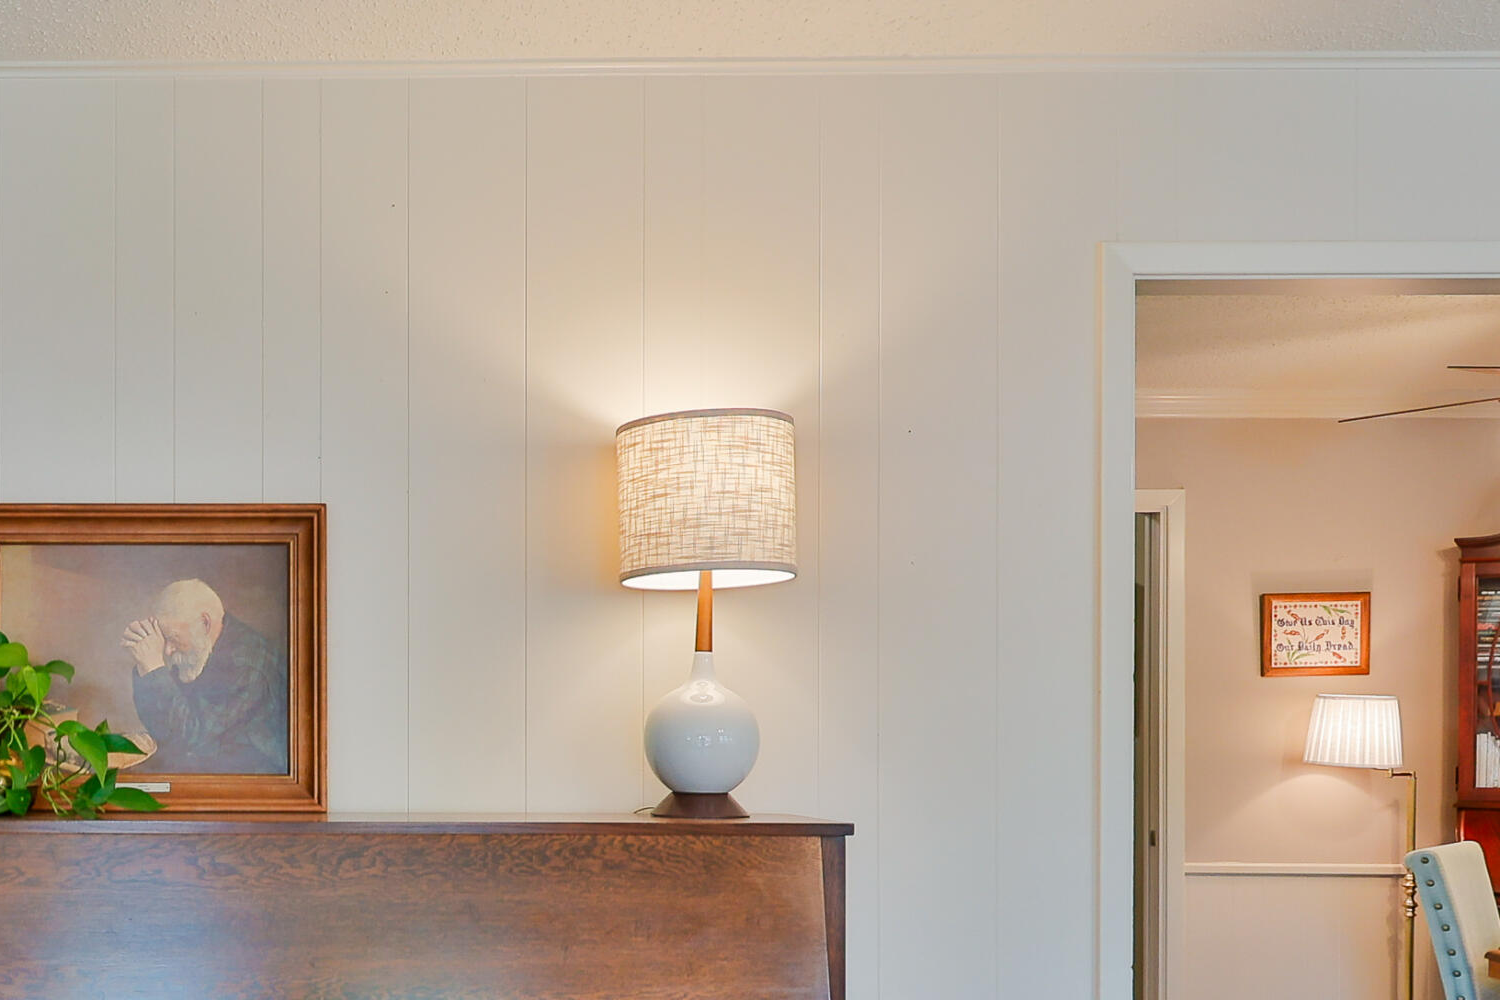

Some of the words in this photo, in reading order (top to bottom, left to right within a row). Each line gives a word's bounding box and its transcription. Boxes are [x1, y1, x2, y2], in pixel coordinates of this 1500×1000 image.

[1276, 618, 1297, 627] Give
[1300, 617, 1312, 626] Us
[1315, 616, 1335, 626] This
[1338, 616, 1355, 628] Day
[1276, 643, 1294, 652] Our
[1298, 641, 1321, 653] Daily
[1325, 641, 1354, 651] Bread
